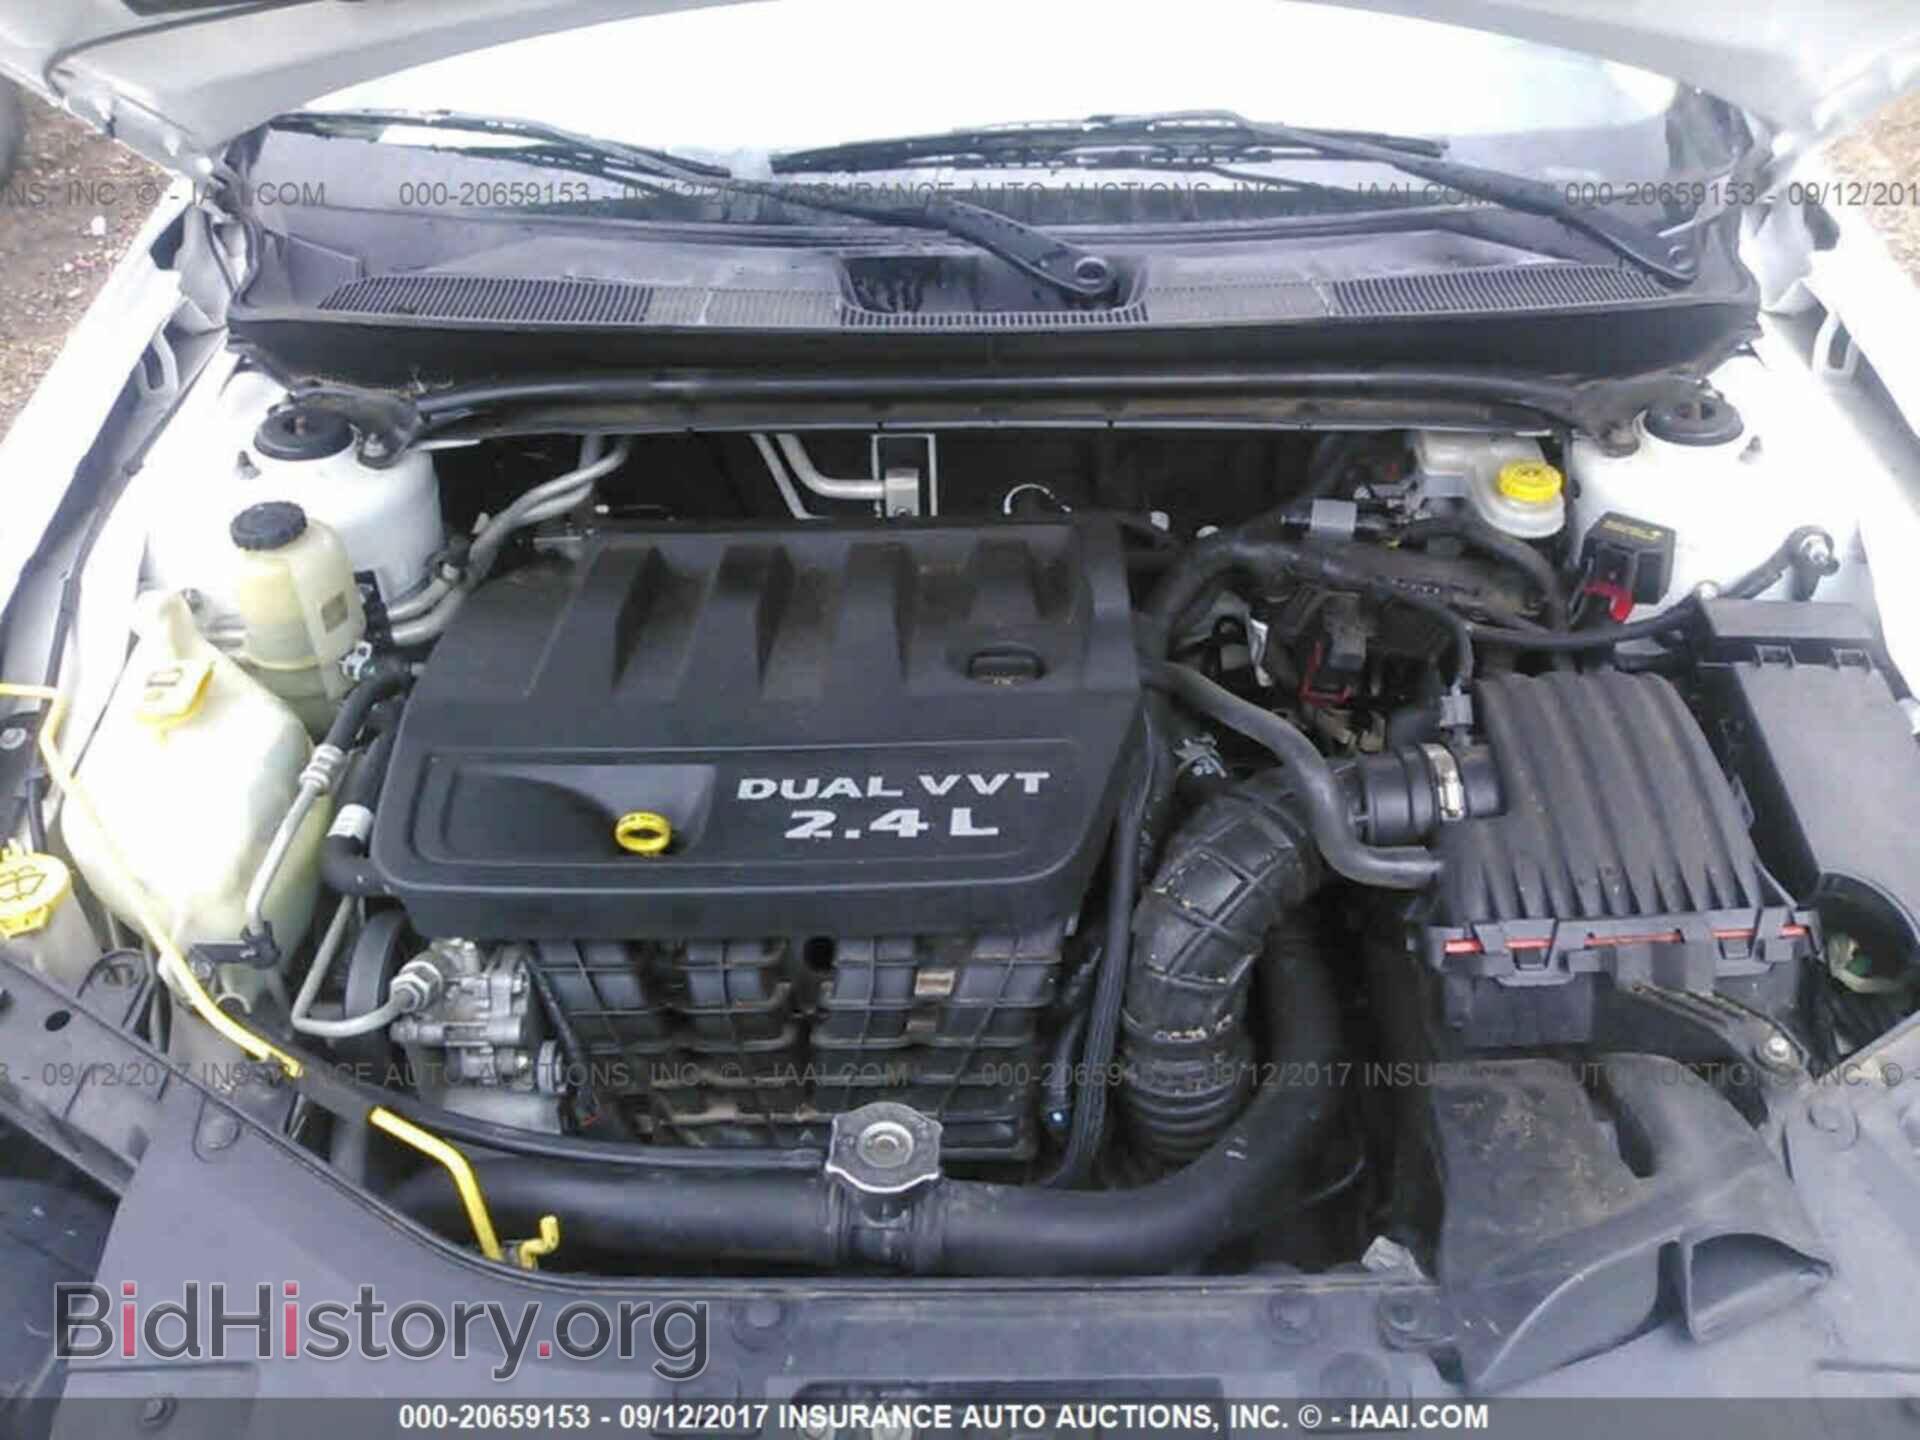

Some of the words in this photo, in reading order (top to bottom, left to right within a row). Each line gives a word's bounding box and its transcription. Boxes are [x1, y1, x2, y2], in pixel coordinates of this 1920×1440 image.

[736, 775, 903, 801] DUAL
[917, 771, 1051, 796] VVT
[783, 808, 930, 840] 2.4
[949, 807, 999, 836] L
